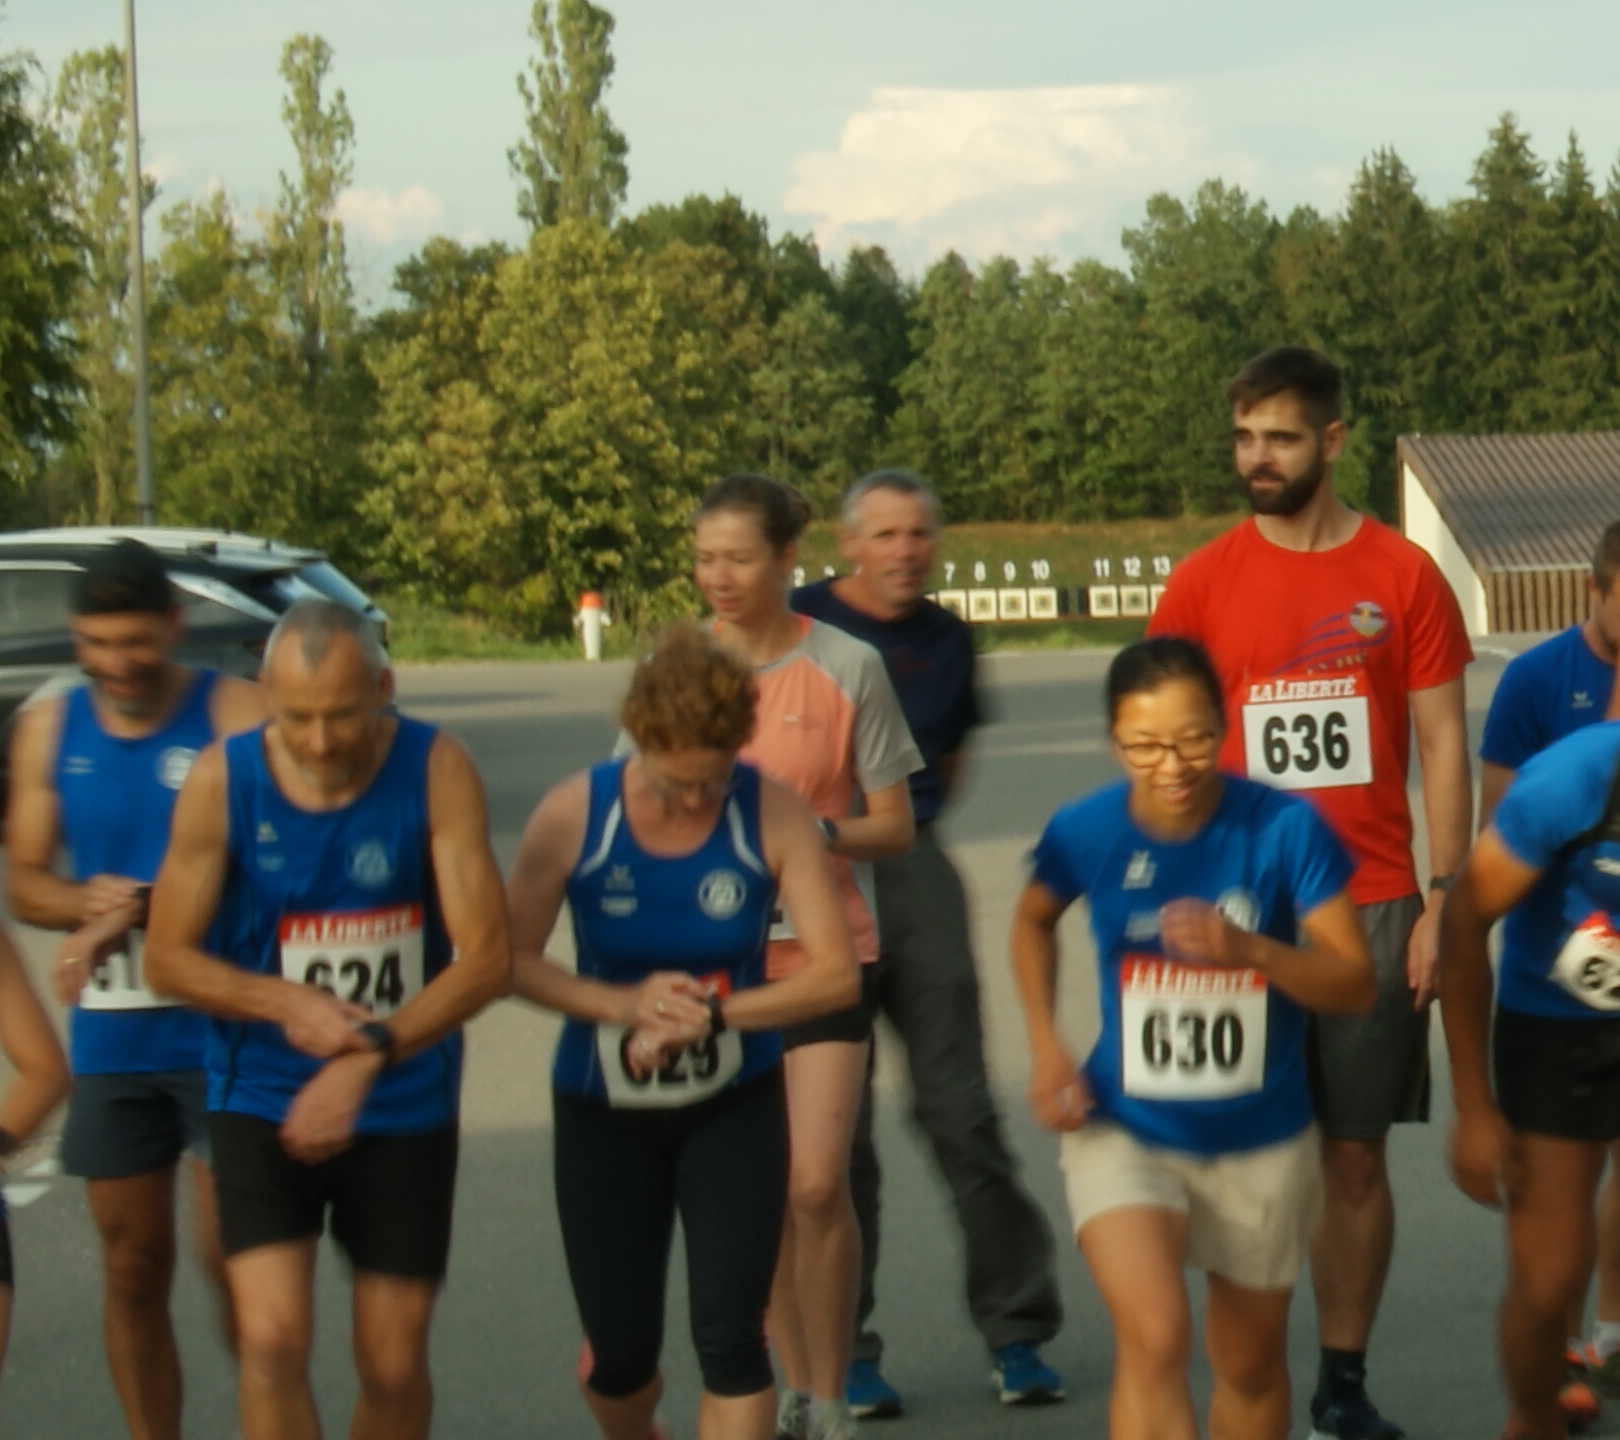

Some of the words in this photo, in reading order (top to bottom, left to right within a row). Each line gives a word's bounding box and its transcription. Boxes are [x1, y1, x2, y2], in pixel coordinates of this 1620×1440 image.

[944, 561, 956, 583] 7
[1003, 561, 1016, 582] 9
[1031, 558, 1050, 580] 10
[1093, 558, 1110, 578] 11
[1122, 556, 1141, 578] 12
[1263, 711, 1350, 775] 636
[303, 949, 404, 1010] 624
[1141, 1009, 1244, 1076] 630
